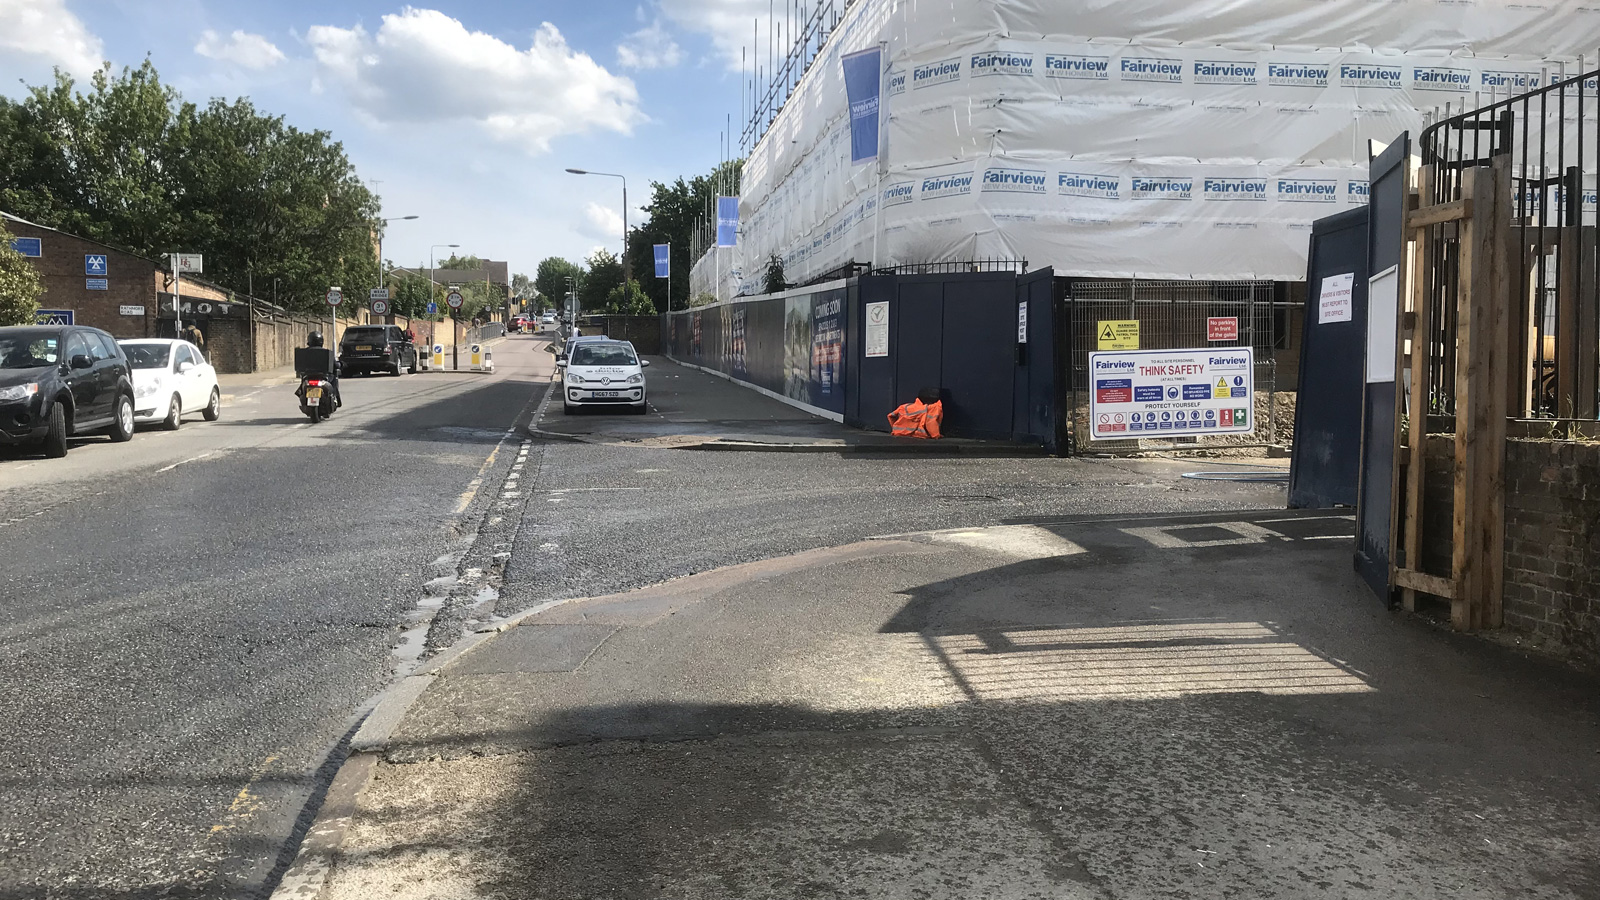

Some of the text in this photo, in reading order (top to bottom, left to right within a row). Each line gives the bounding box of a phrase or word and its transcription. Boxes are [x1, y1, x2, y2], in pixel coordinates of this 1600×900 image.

[971, 53, 1033, 68] Fairview
[1046, 56, 1108, 72] Fairview
[1120, 60, 1182, 74] Fairview
[913, 62, 960, 81] Fairview
[1194, 62, 1256, 77] Fairview
[1268, 65, 1329, 79] Fairview
[1340, 66, 1402, 80] Fairview
[1414, 69, 1470, 84] Fairview
[922, 174, 972, 192] Fairview
[982, 171, 1046, 184] Fairview
[1058, 174, 1118, 190] Fairview
[1132, 180, 1192, 192] Fairview
[1204, 180, 1266, 192] Fairview
[1278, 182, 1336, 194] Fairview
[816, 298, 840, 320] COMING SOON
[1209, 357, 1246, 365] Fairview
[1139, 364, 1204, 376] THINK SAFETY
